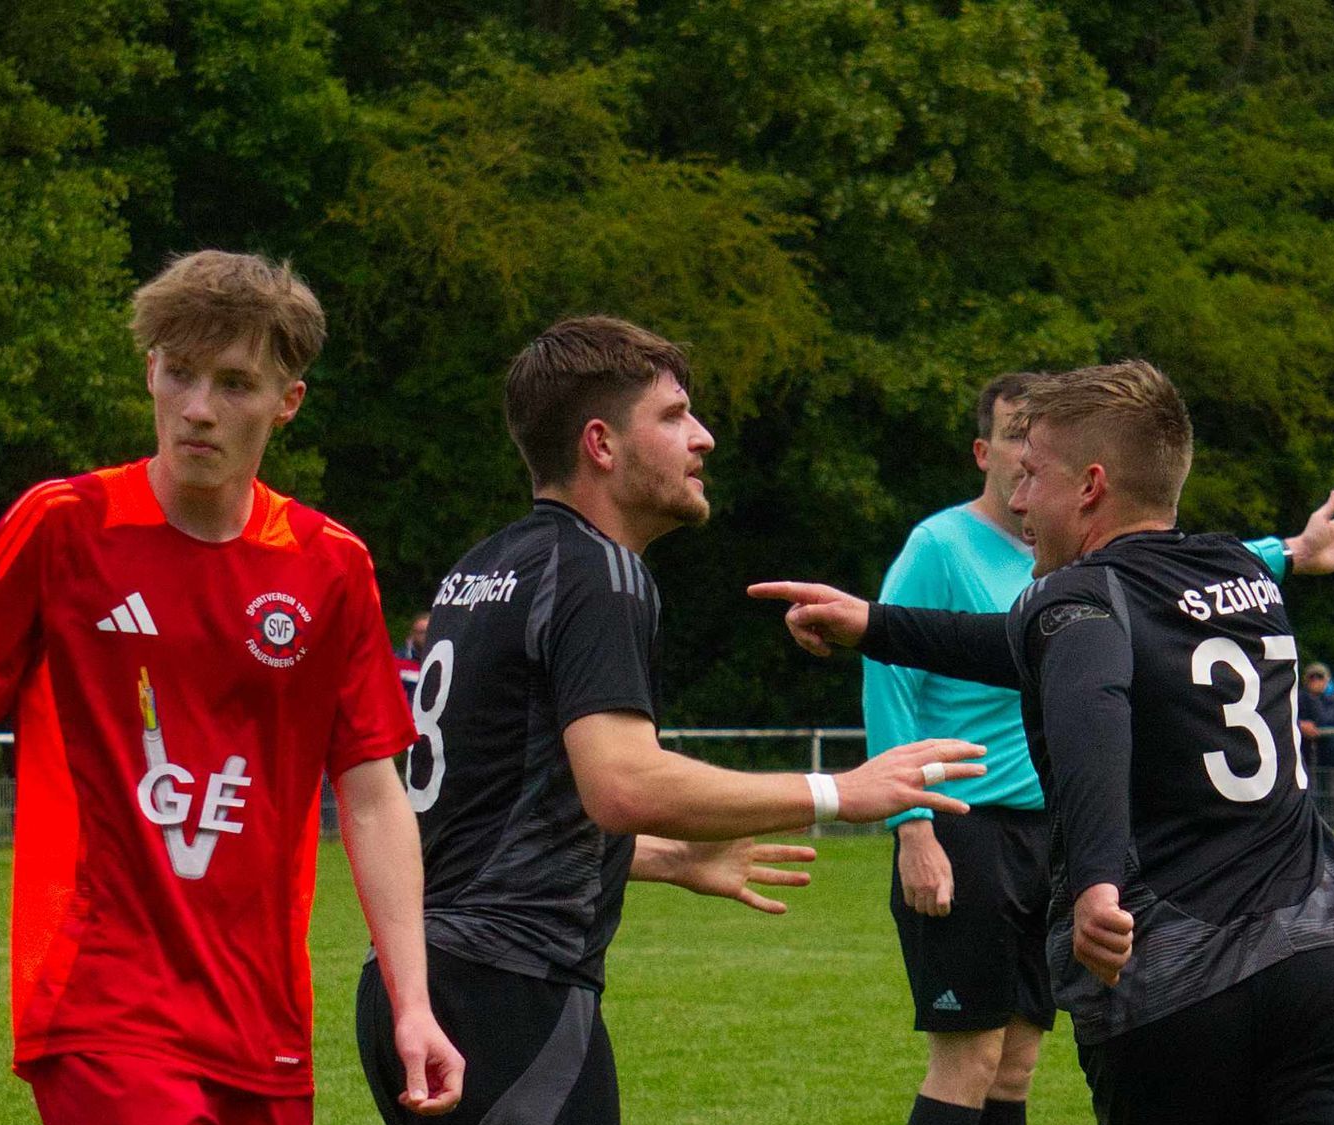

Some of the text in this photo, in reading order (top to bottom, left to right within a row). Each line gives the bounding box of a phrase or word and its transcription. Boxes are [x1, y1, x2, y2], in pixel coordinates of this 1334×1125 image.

[245, 592, 297, 617] SPORTVEREIN
[268, 618, 292, 639] SVF
[245, 638, 296, 669] FRAUENBERG
[1191, 635, 1308, 802] 37
